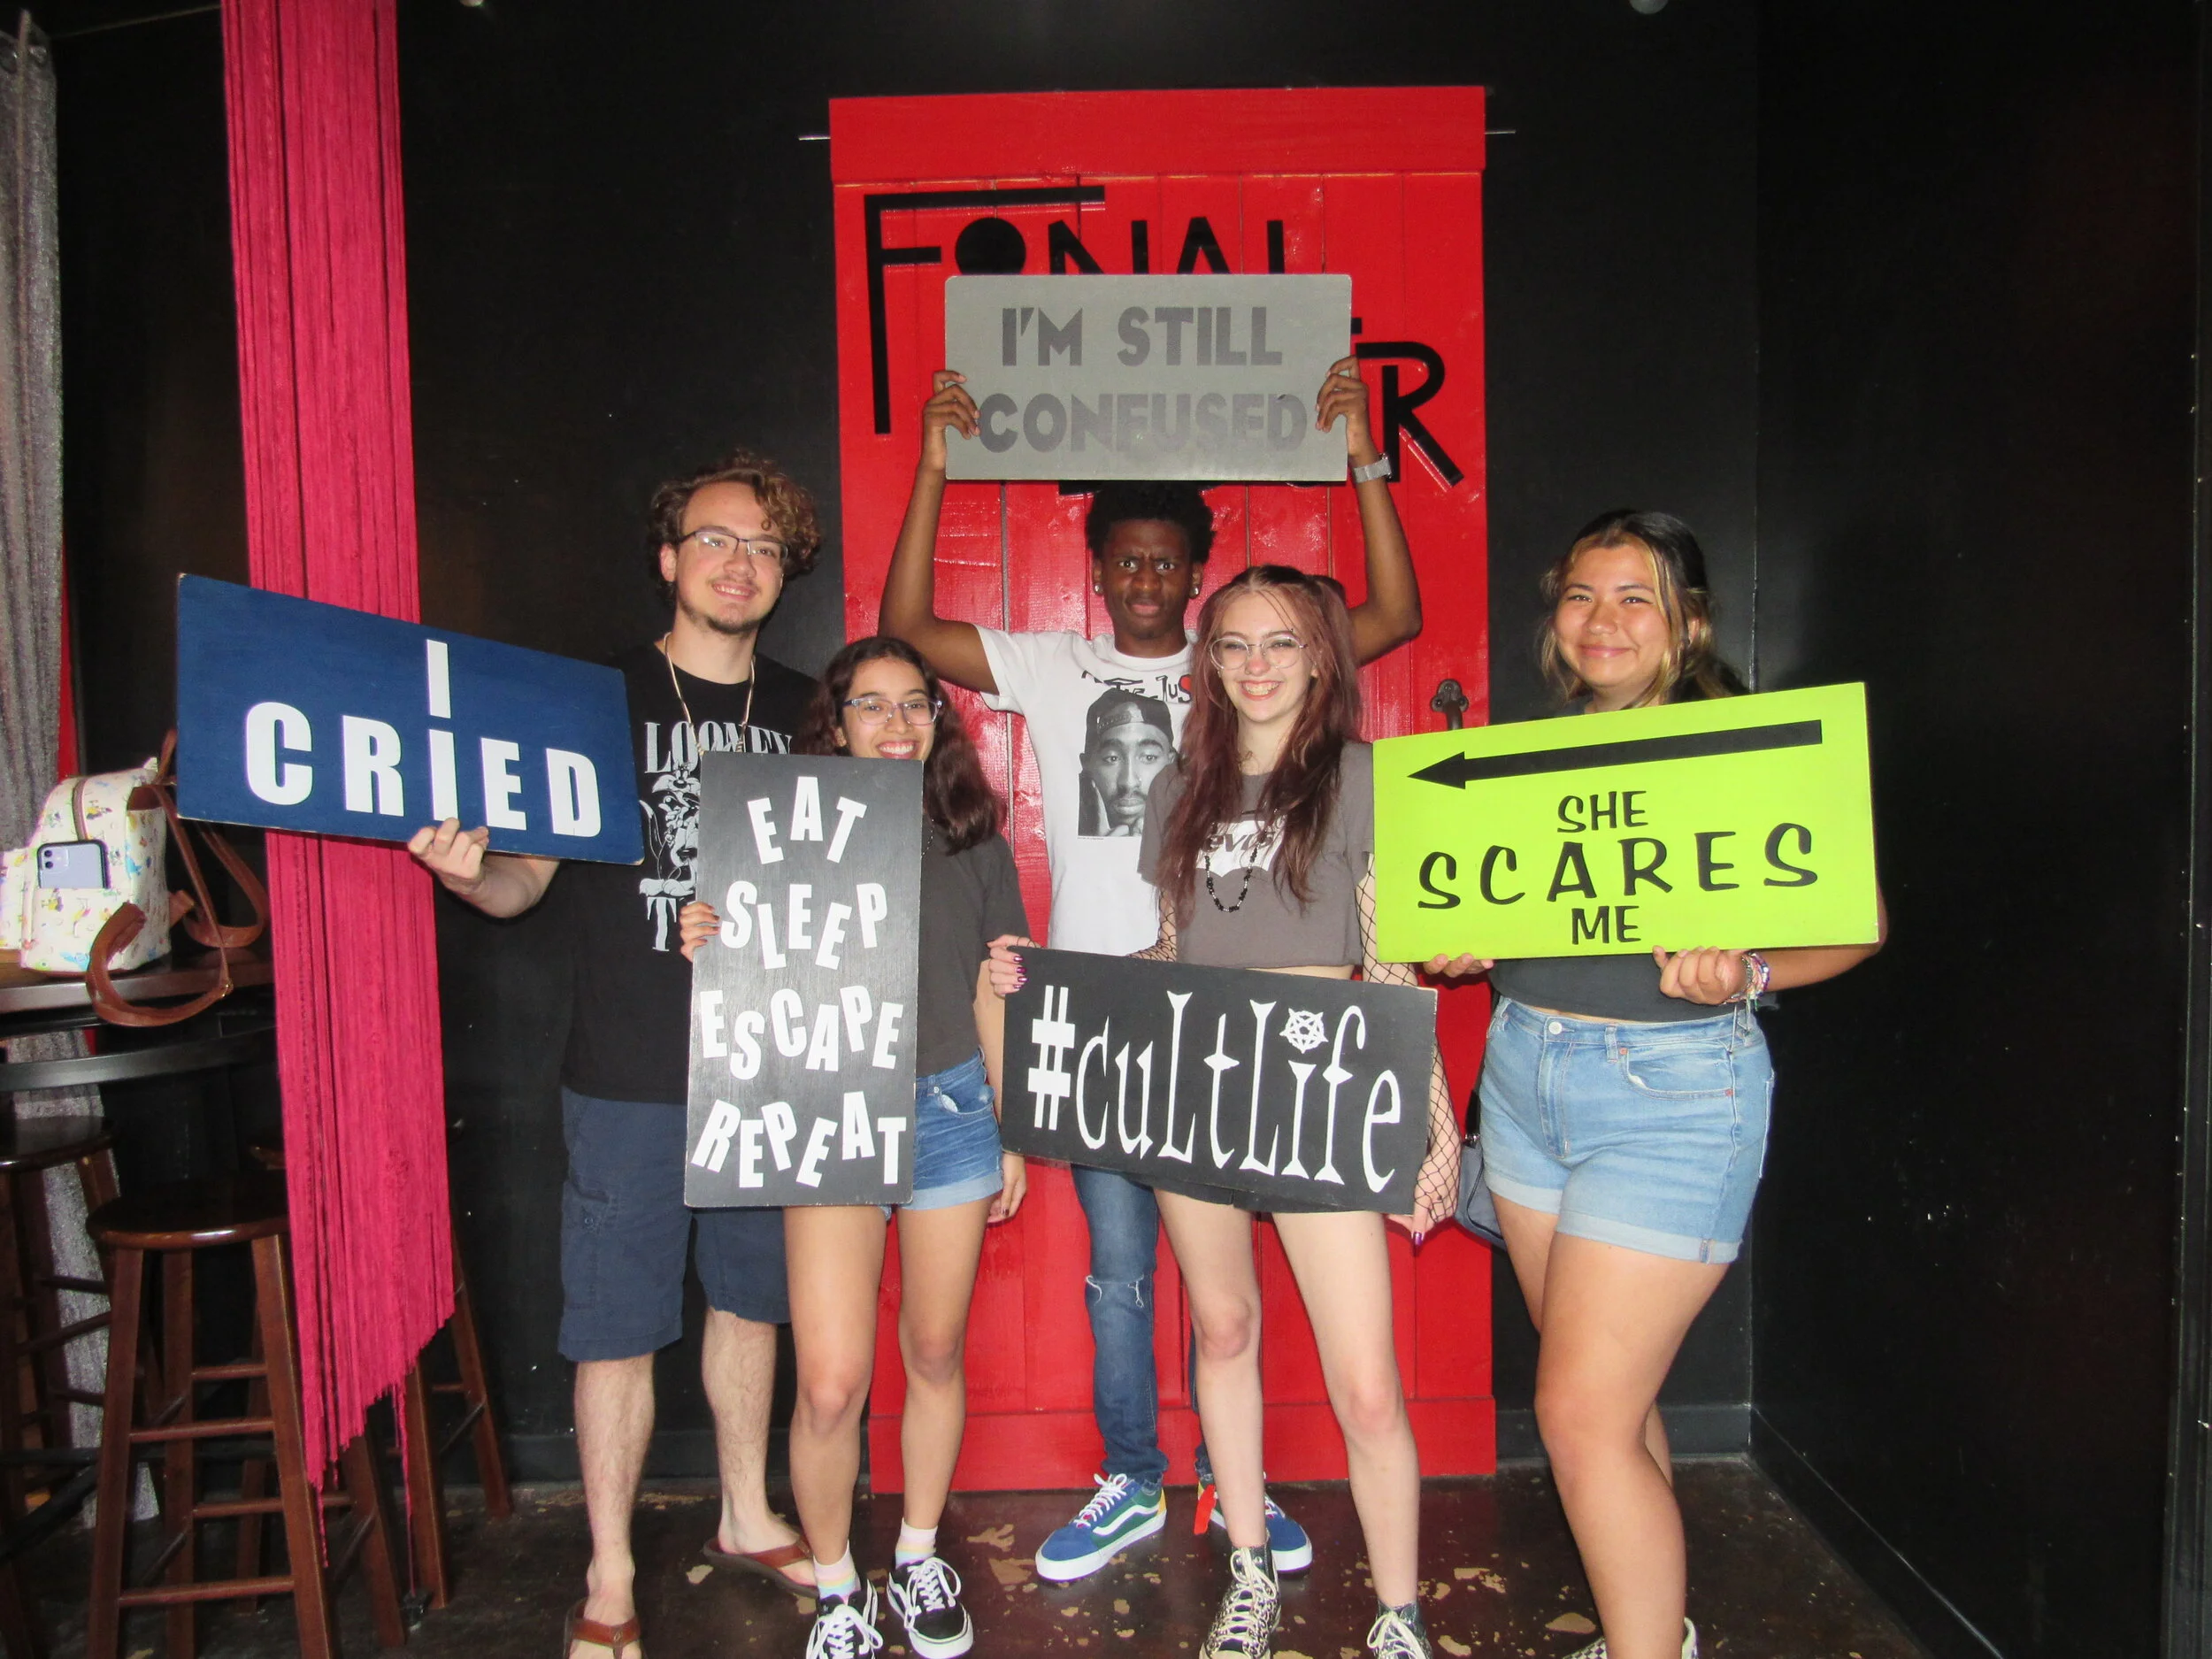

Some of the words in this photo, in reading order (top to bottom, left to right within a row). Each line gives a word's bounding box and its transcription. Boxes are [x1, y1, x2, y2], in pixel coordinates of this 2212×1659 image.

[1002, 306, 1083, 366] I'M
[1118, 306, 1283, 367] STILL
[979, 393, 1308, 453] CONFUSED
[426, 639, 452, 718] I
[244, 701, 603, 838] CRIED
[1557, 790, 1649, 833] SHE
[747, 776, 867, 864] EAT
[1417, 822, 1819, 910] SCARES
[720, 880, 888, 971] SLEEP
[1571, 904, 1643, 946] ME
[699, 985, 903, 1081] ESCAPE
[690, 1090, 907, 1189] REPEAT
